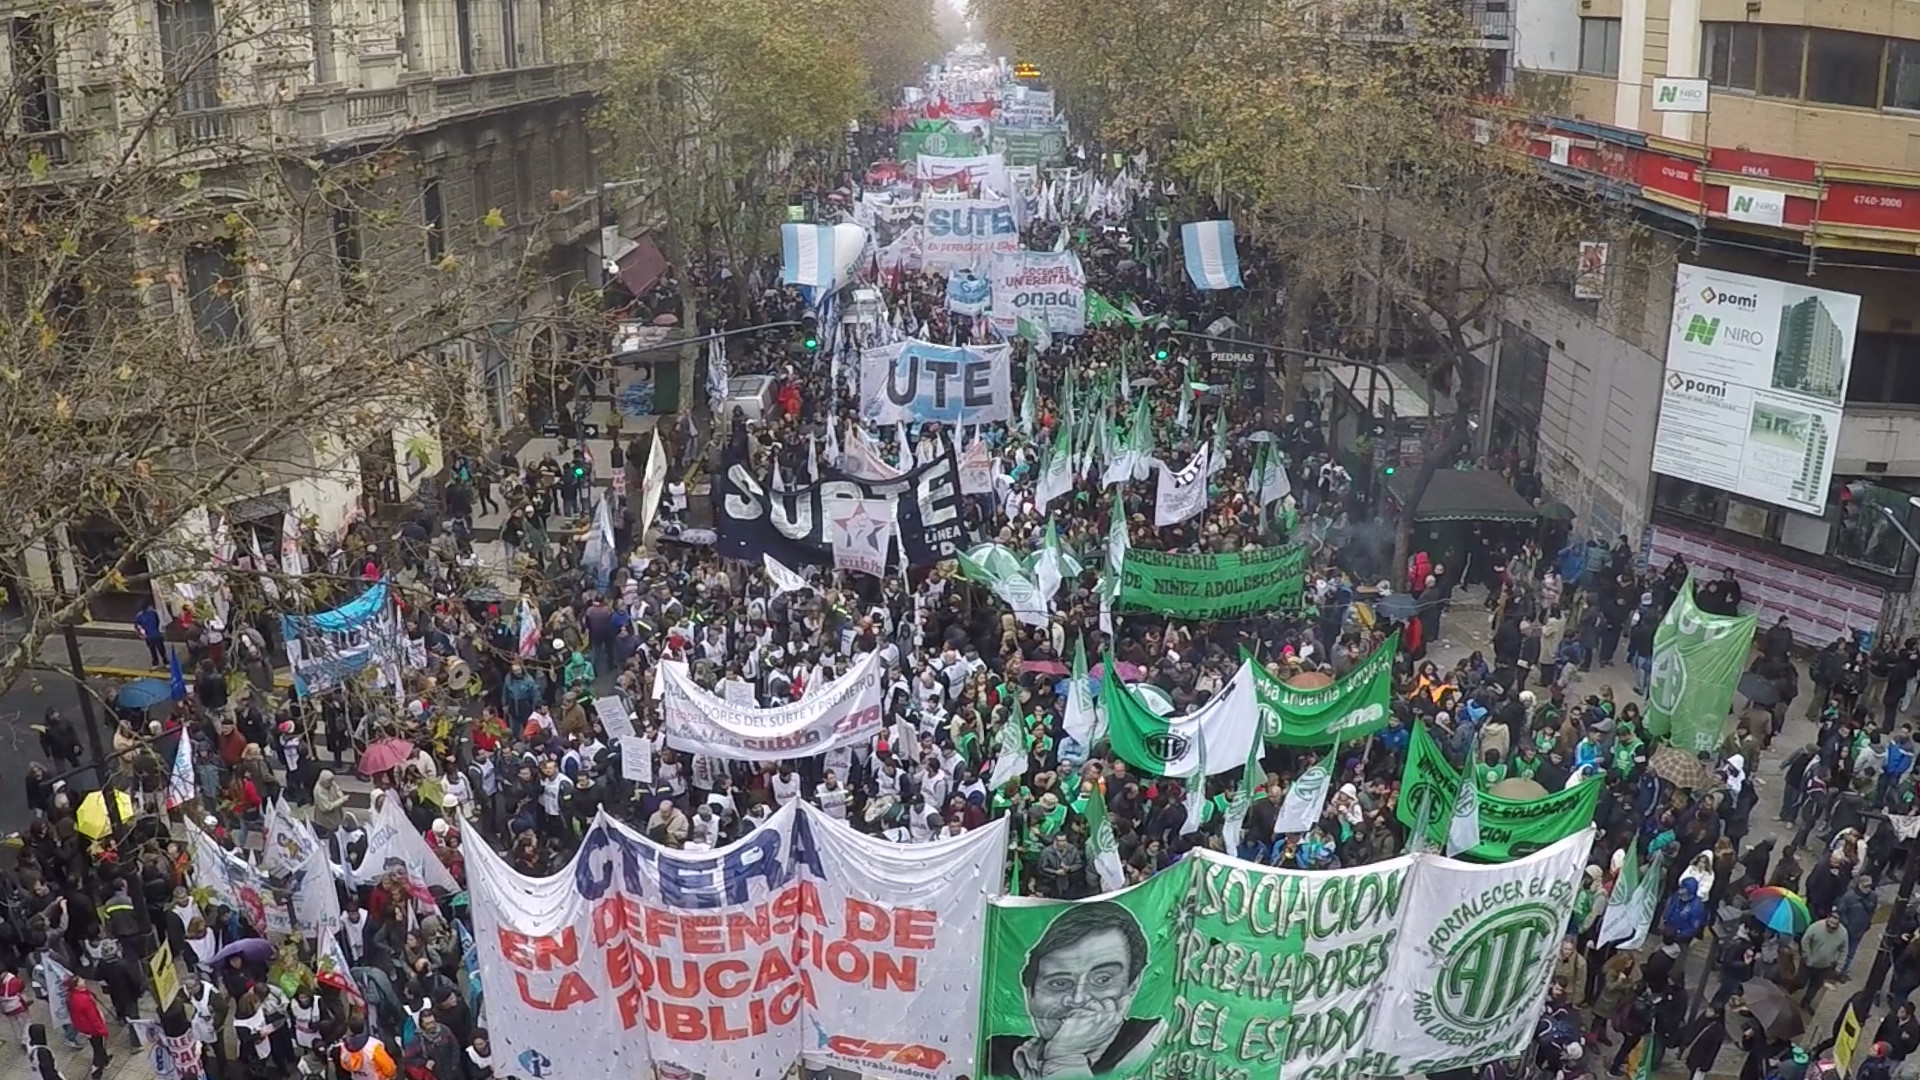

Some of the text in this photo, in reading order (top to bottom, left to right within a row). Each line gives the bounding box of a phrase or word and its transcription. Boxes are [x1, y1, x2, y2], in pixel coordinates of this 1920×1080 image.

[1680, 89, 1703, 100] NIRO
[1755, 201, 1779, 212] NIRO
[1853, 194, 1903, 208] 4740-3000
[928, 205, 1017, 237] SUTE
[1717, 291, 1758, 309] pami
[1723, 325, 1764, 346] NIRO
[1210, 352, 1255, 363] PIEDRAS
[886, 355, 993, 408] UTE
[1685, 379, 1727, 397] pami
[1124, 572, 1143, 589] DE
[743, 714, 767, 728] DEL
[769, 711, 806, 726] SUBTE
[575, 807, 827, 910] CTERA
[1183, 857, 1410, 941] ASOCIACION
[1427, 878, 1524, 951] FORTALECER
[1529, 877, 1547, 895] EL
[498, 879, 937, 971] EN DEFENSA DE
[514, 927, 917, 1011] LA EDUCACION
[1450, 915, 1552, 1020] ATE
[618, 968, 818, 1042] PUBLICA
[1413, 989, 1433, 1026] PARA
[1240, 1000, 1373, 1062] ESTADO
[860, 1058, 938, 1080] trabajadores
